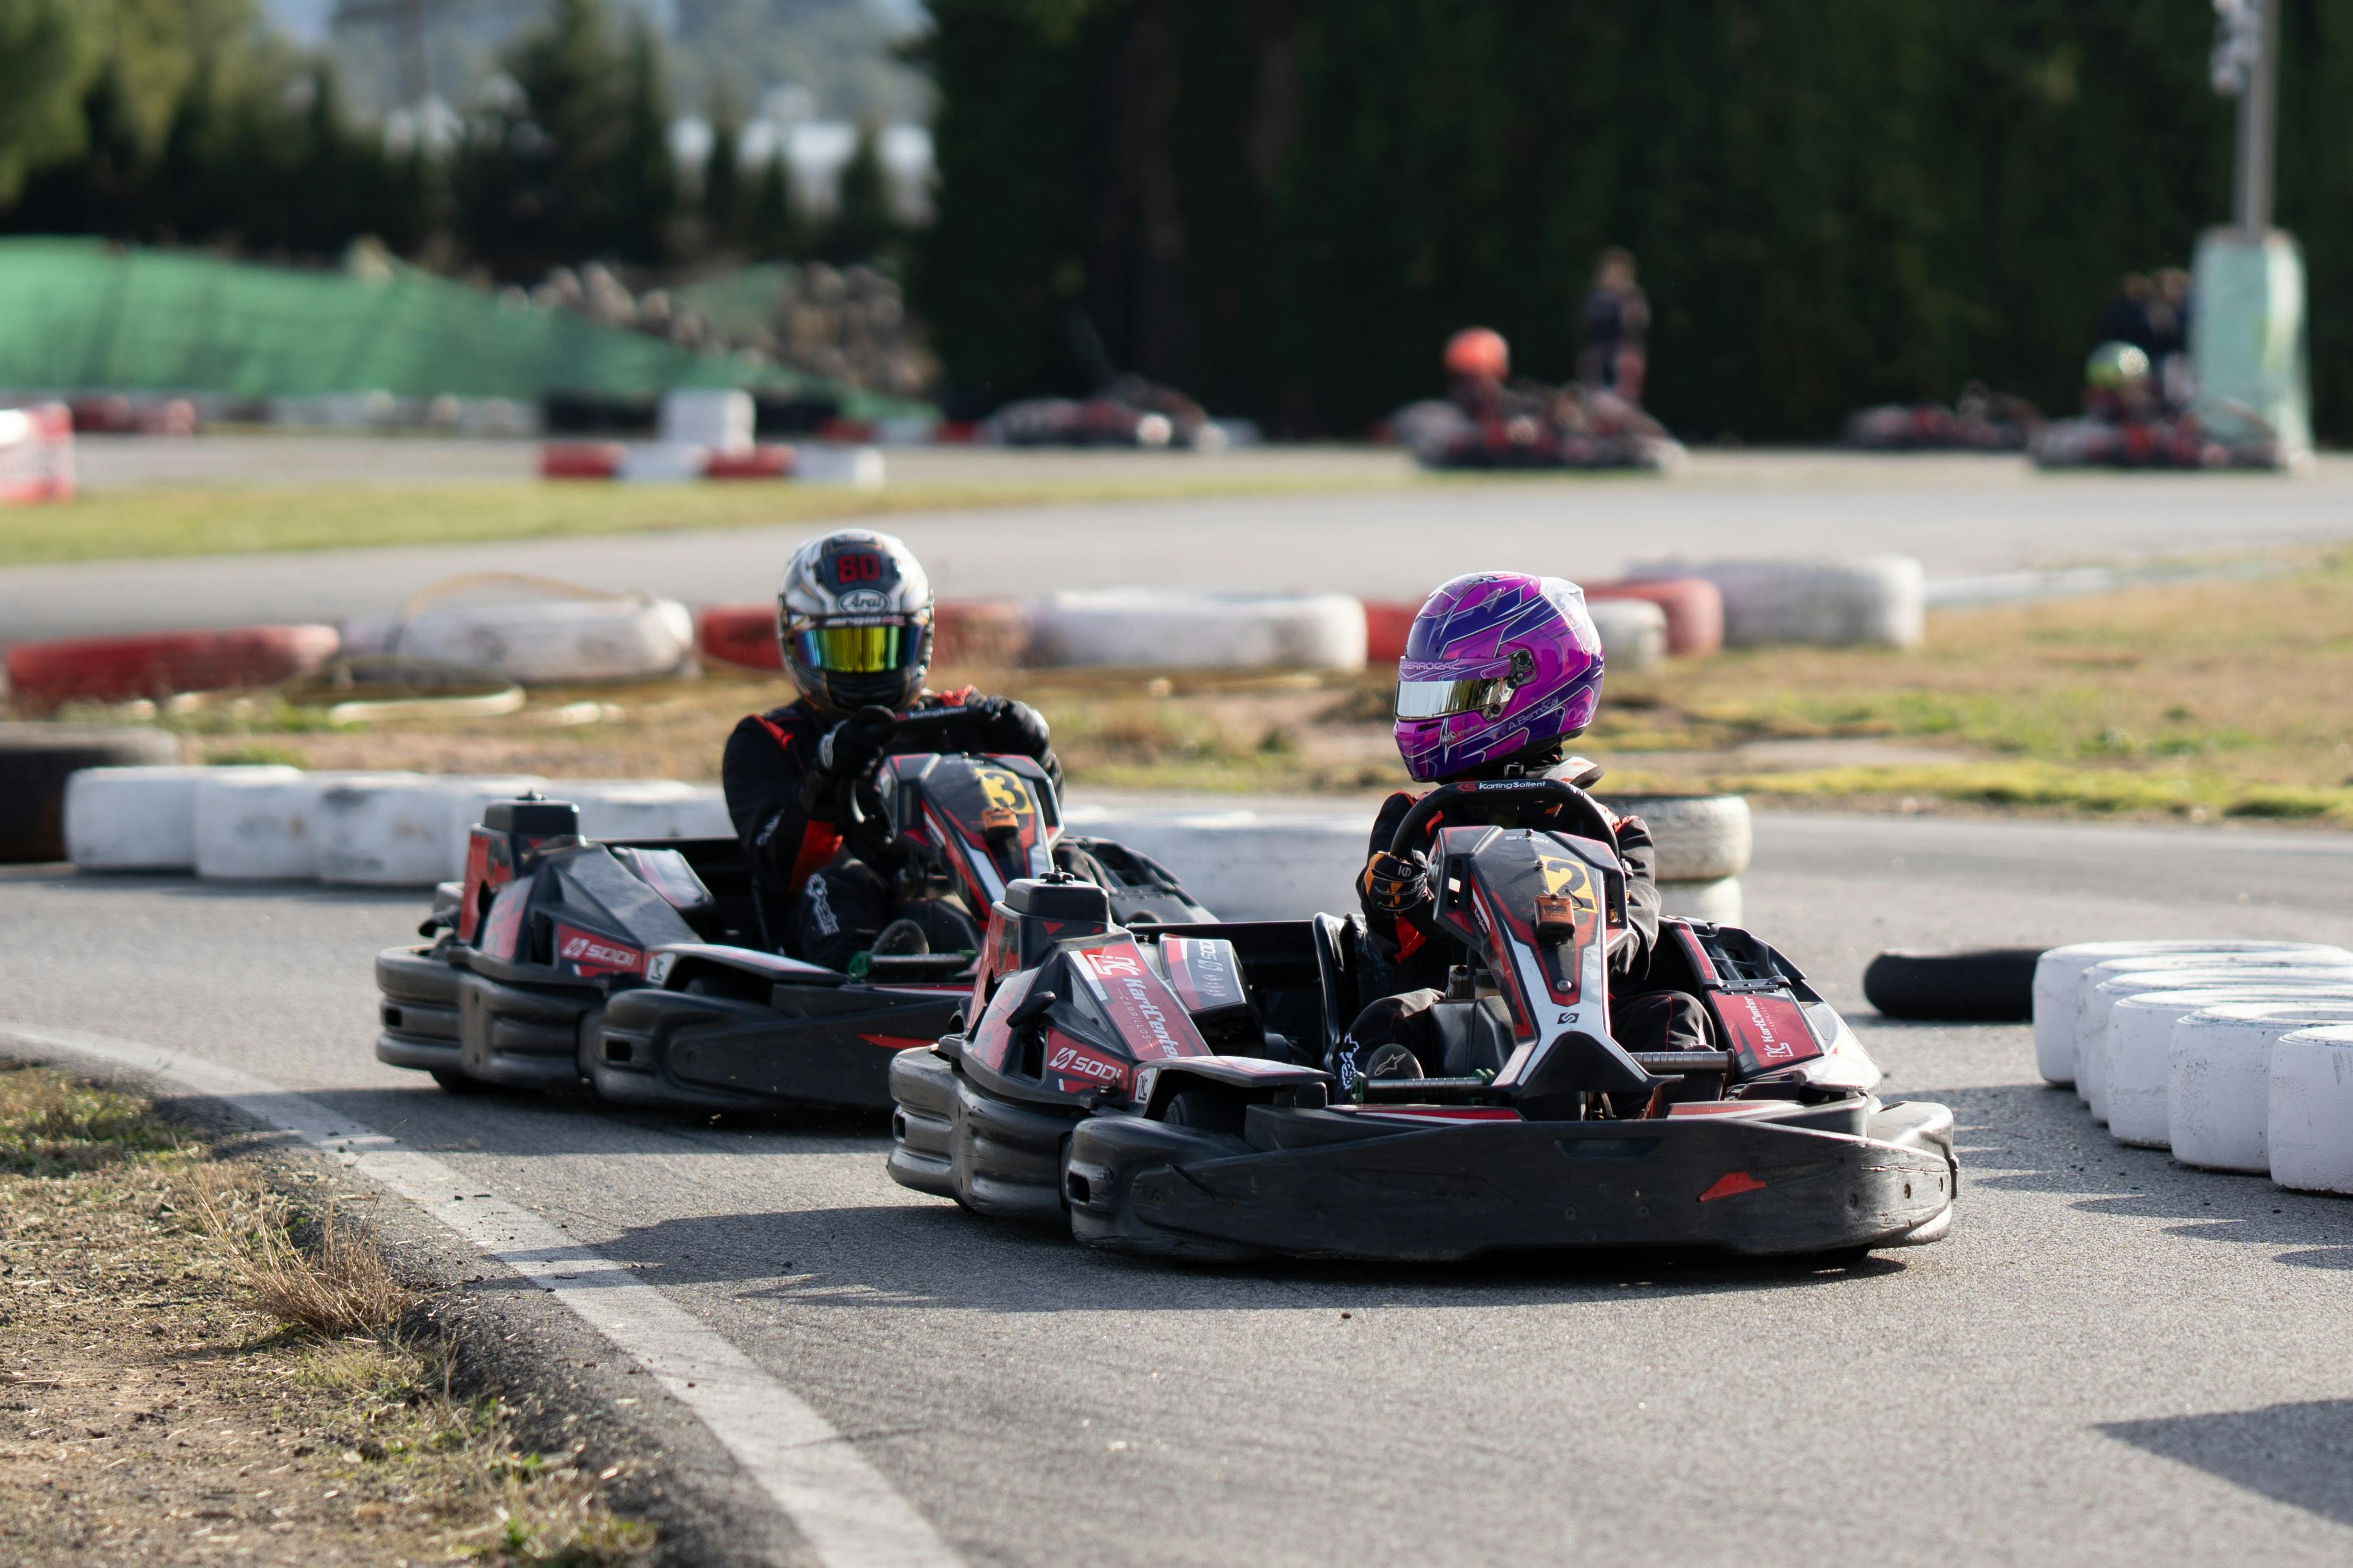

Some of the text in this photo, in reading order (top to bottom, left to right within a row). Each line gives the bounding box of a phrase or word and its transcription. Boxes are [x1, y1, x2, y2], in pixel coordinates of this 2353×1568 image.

[837, 553, 881, 583] 80
[984, 772, 1026, 809] 3
[1546, 860, 1594, 910] 2
[1744, 996, 1775, 1042] KartCenter
